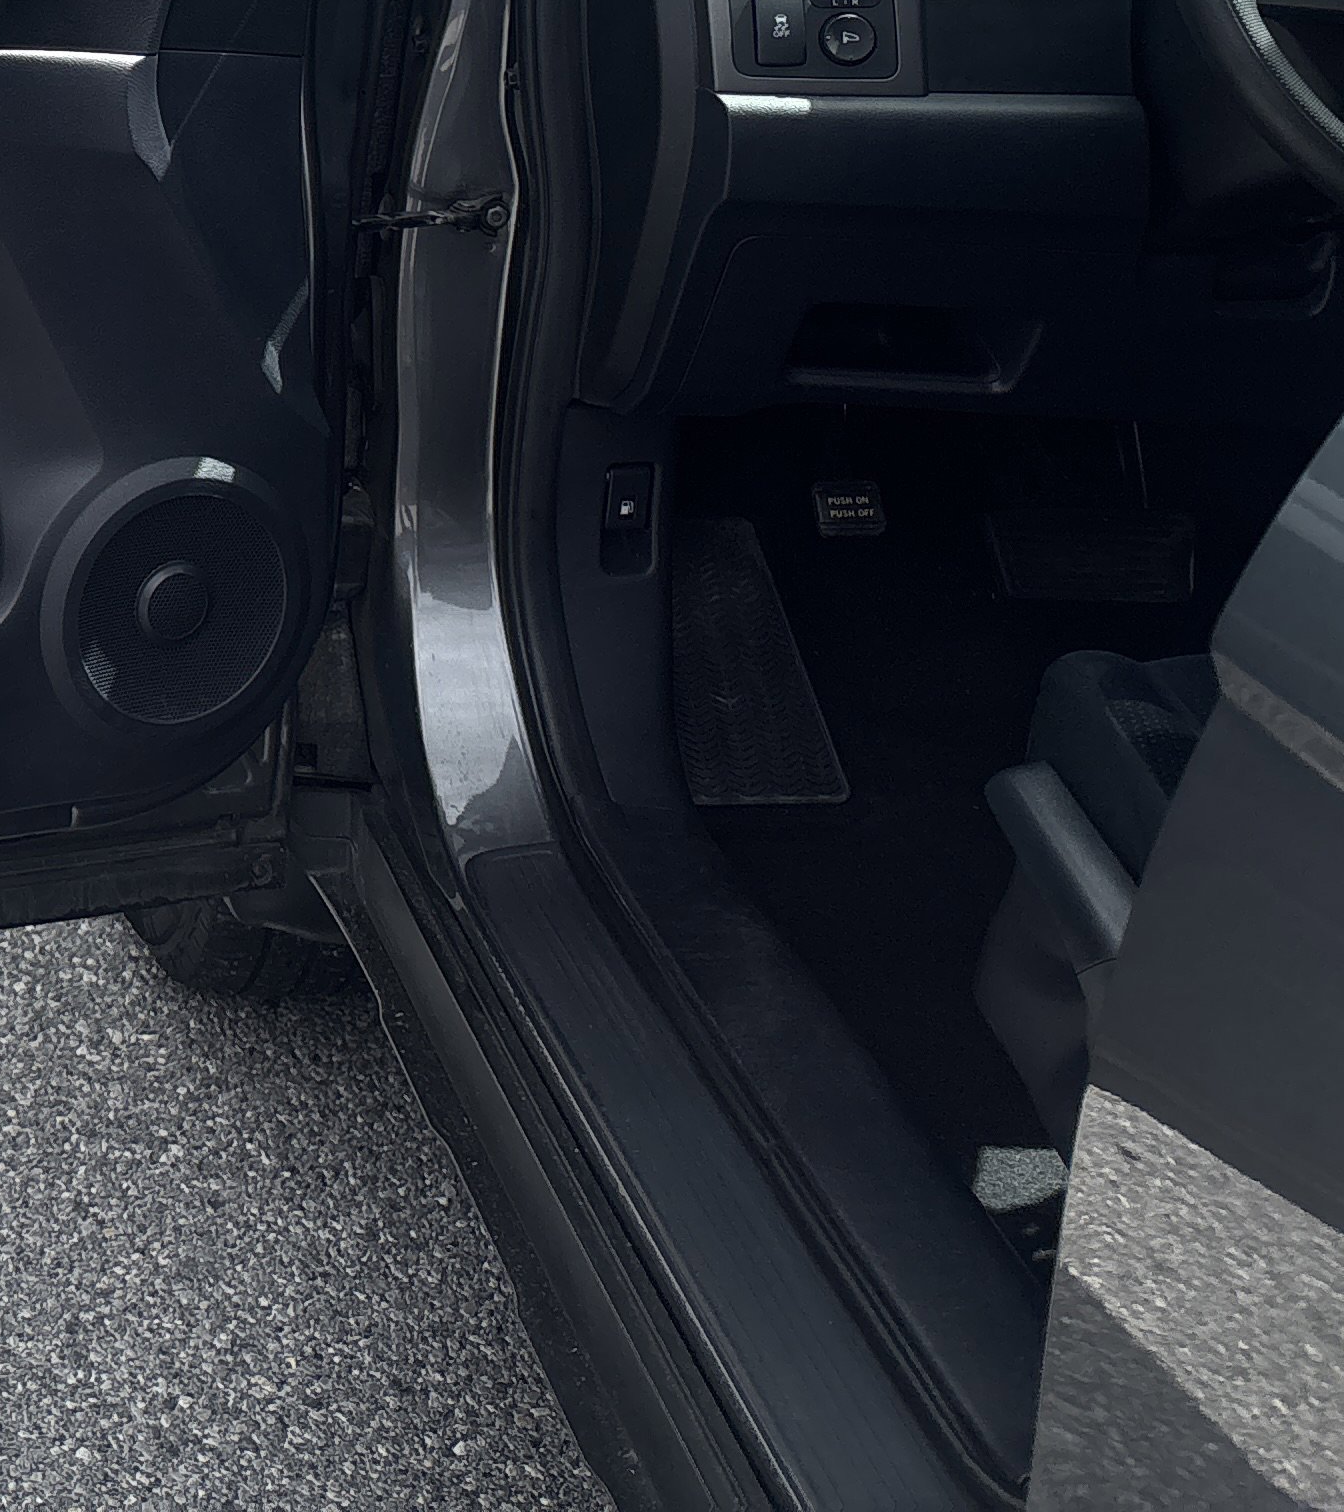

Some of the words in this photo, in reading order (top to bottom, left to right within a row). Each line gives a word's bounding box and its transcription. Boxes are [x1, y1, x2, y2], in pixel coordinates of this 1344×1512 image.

[772, 30, 791, 38] OFF
[827, 496, 853, 505] PUSH
[829, 509, 856, 518] PUSH
[857, 508, 874, 517] OFF
